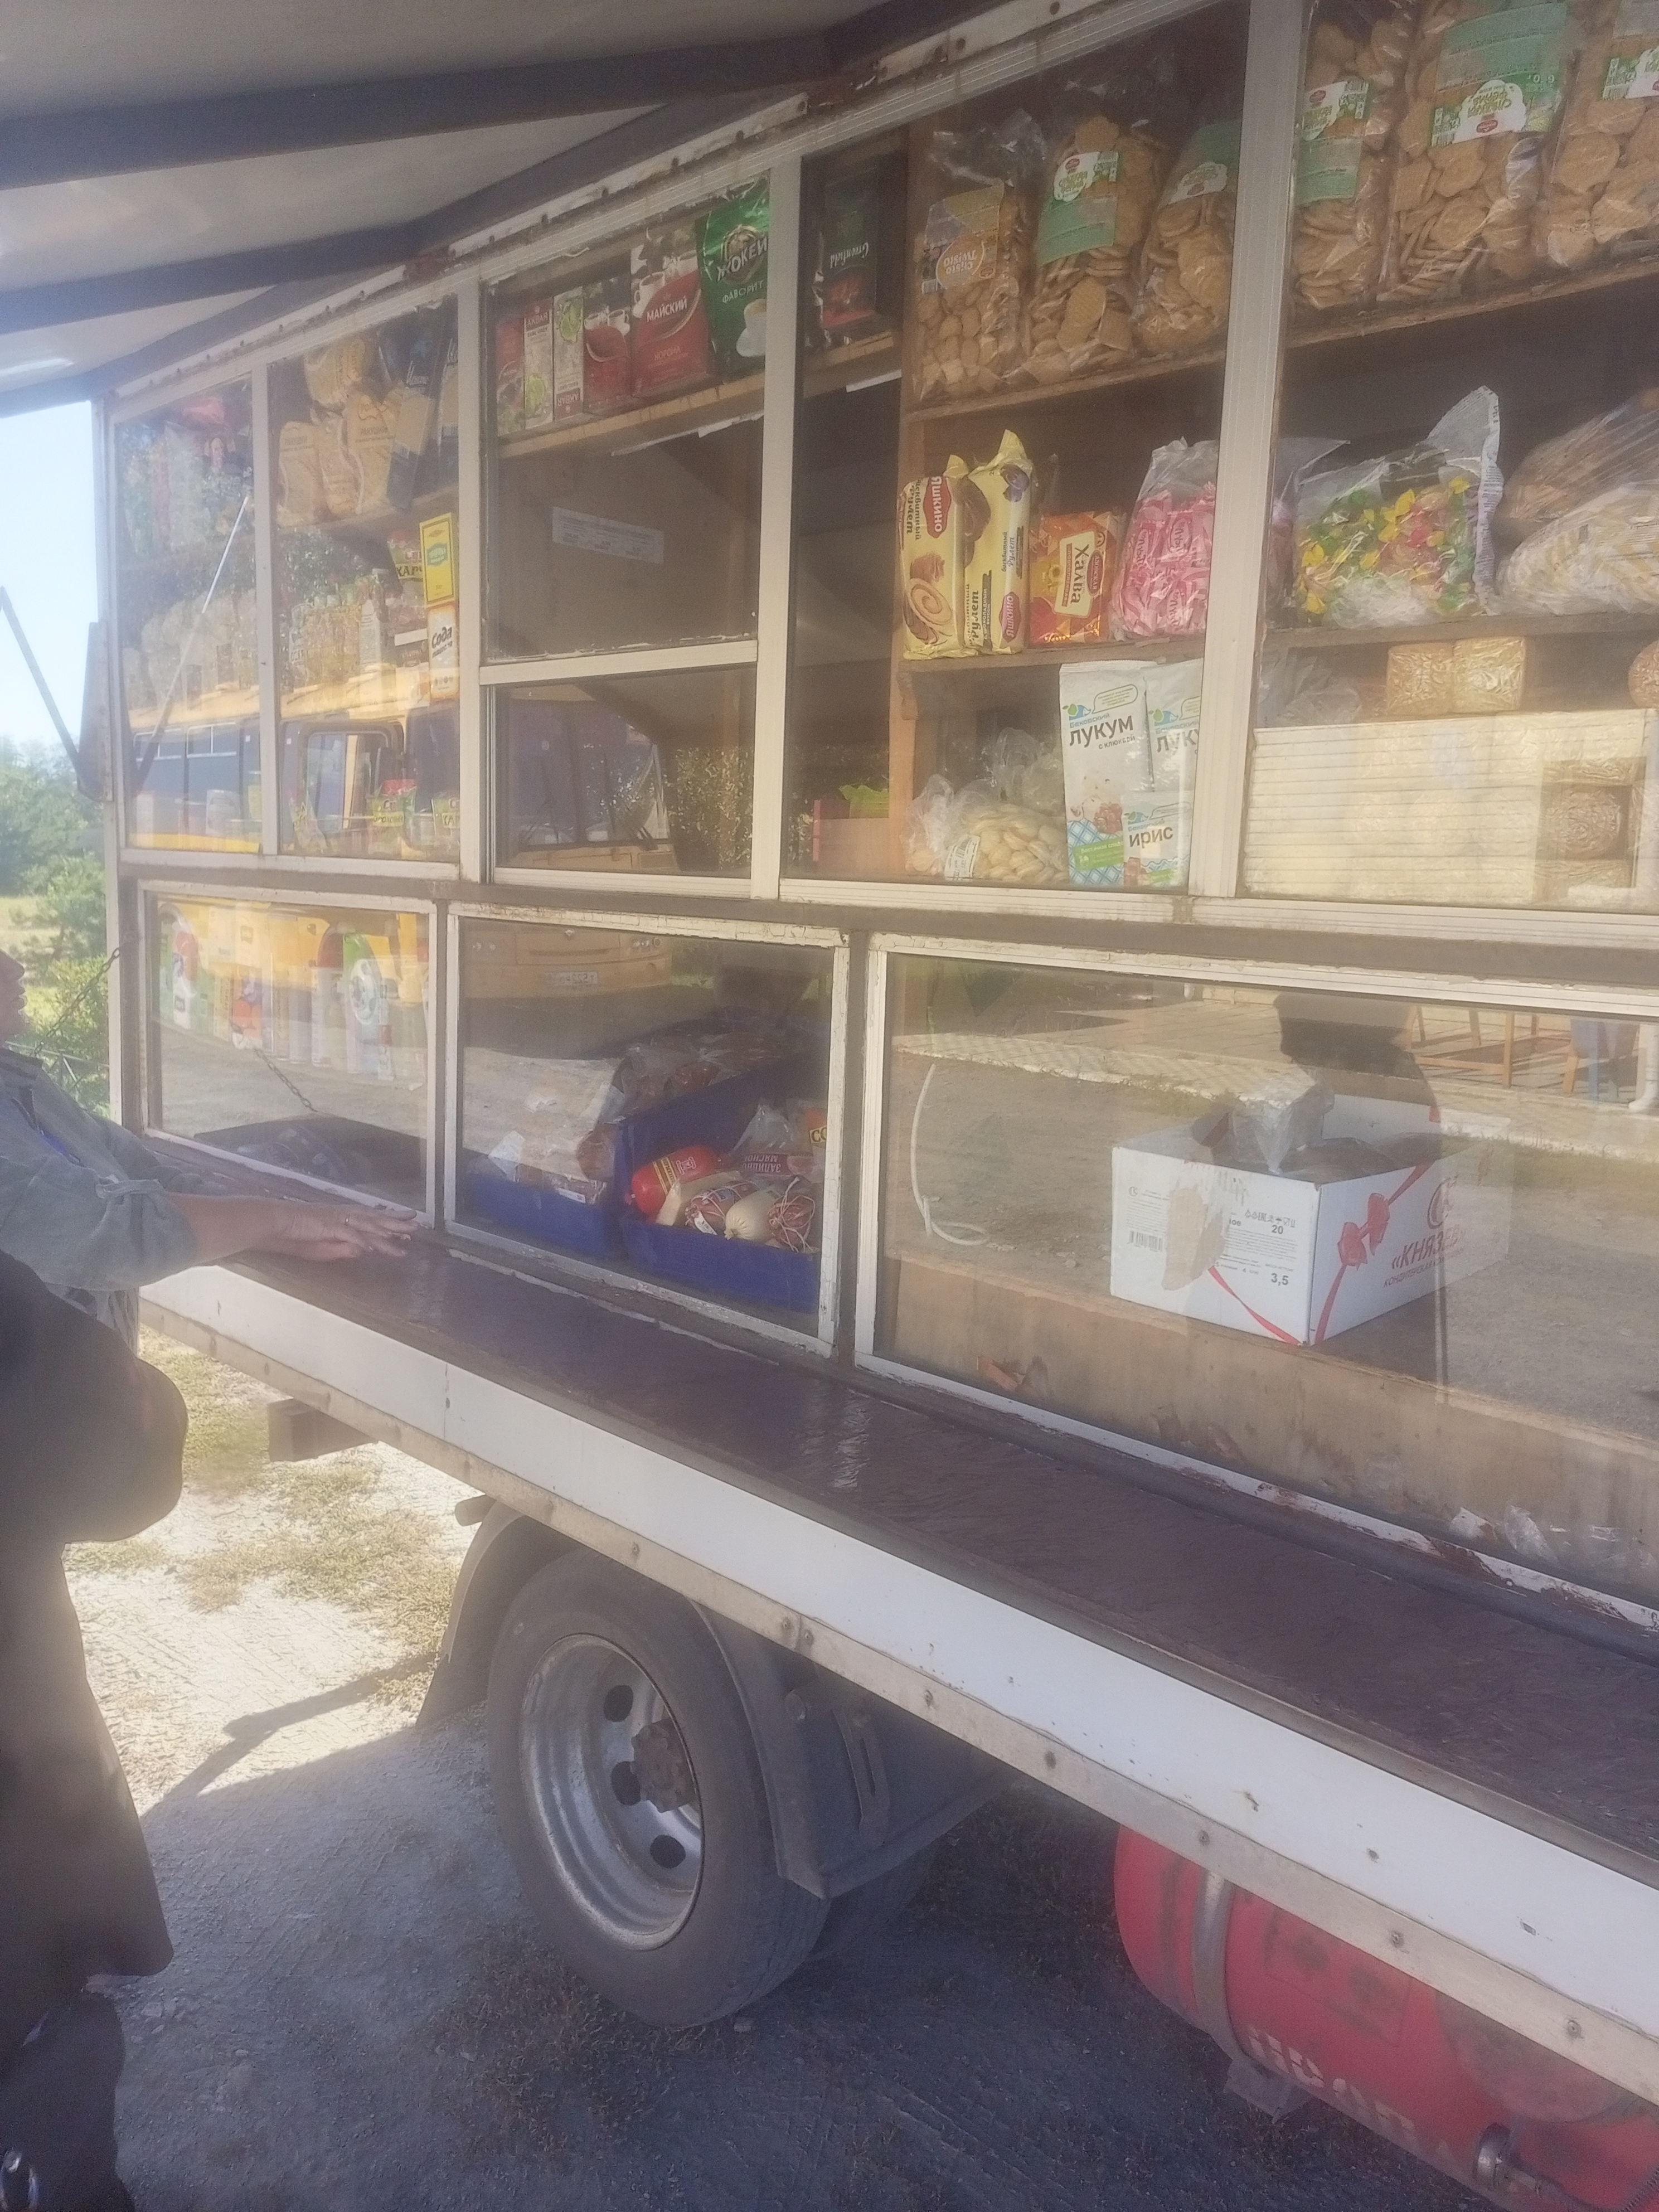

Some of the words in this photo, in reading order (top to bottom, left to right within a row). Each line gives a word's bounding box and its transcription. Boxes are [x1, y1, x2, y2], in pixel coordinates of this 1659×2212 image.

[830, 242, 869, 269] Greenfield
[722, 280, 764, 303] ФАВОРИТ
[647, 295, 687, 322] МАЙСКИЙ
[1070, 544, 1090, 604] Халва
[1092, 555, 1100, 590] АЗОВСКАЯ
[431, 626, 453, 649] Сода
[1271, 1224, 1284, 1235] 20
[1270, 1272, 1289, 1287] 3,5
